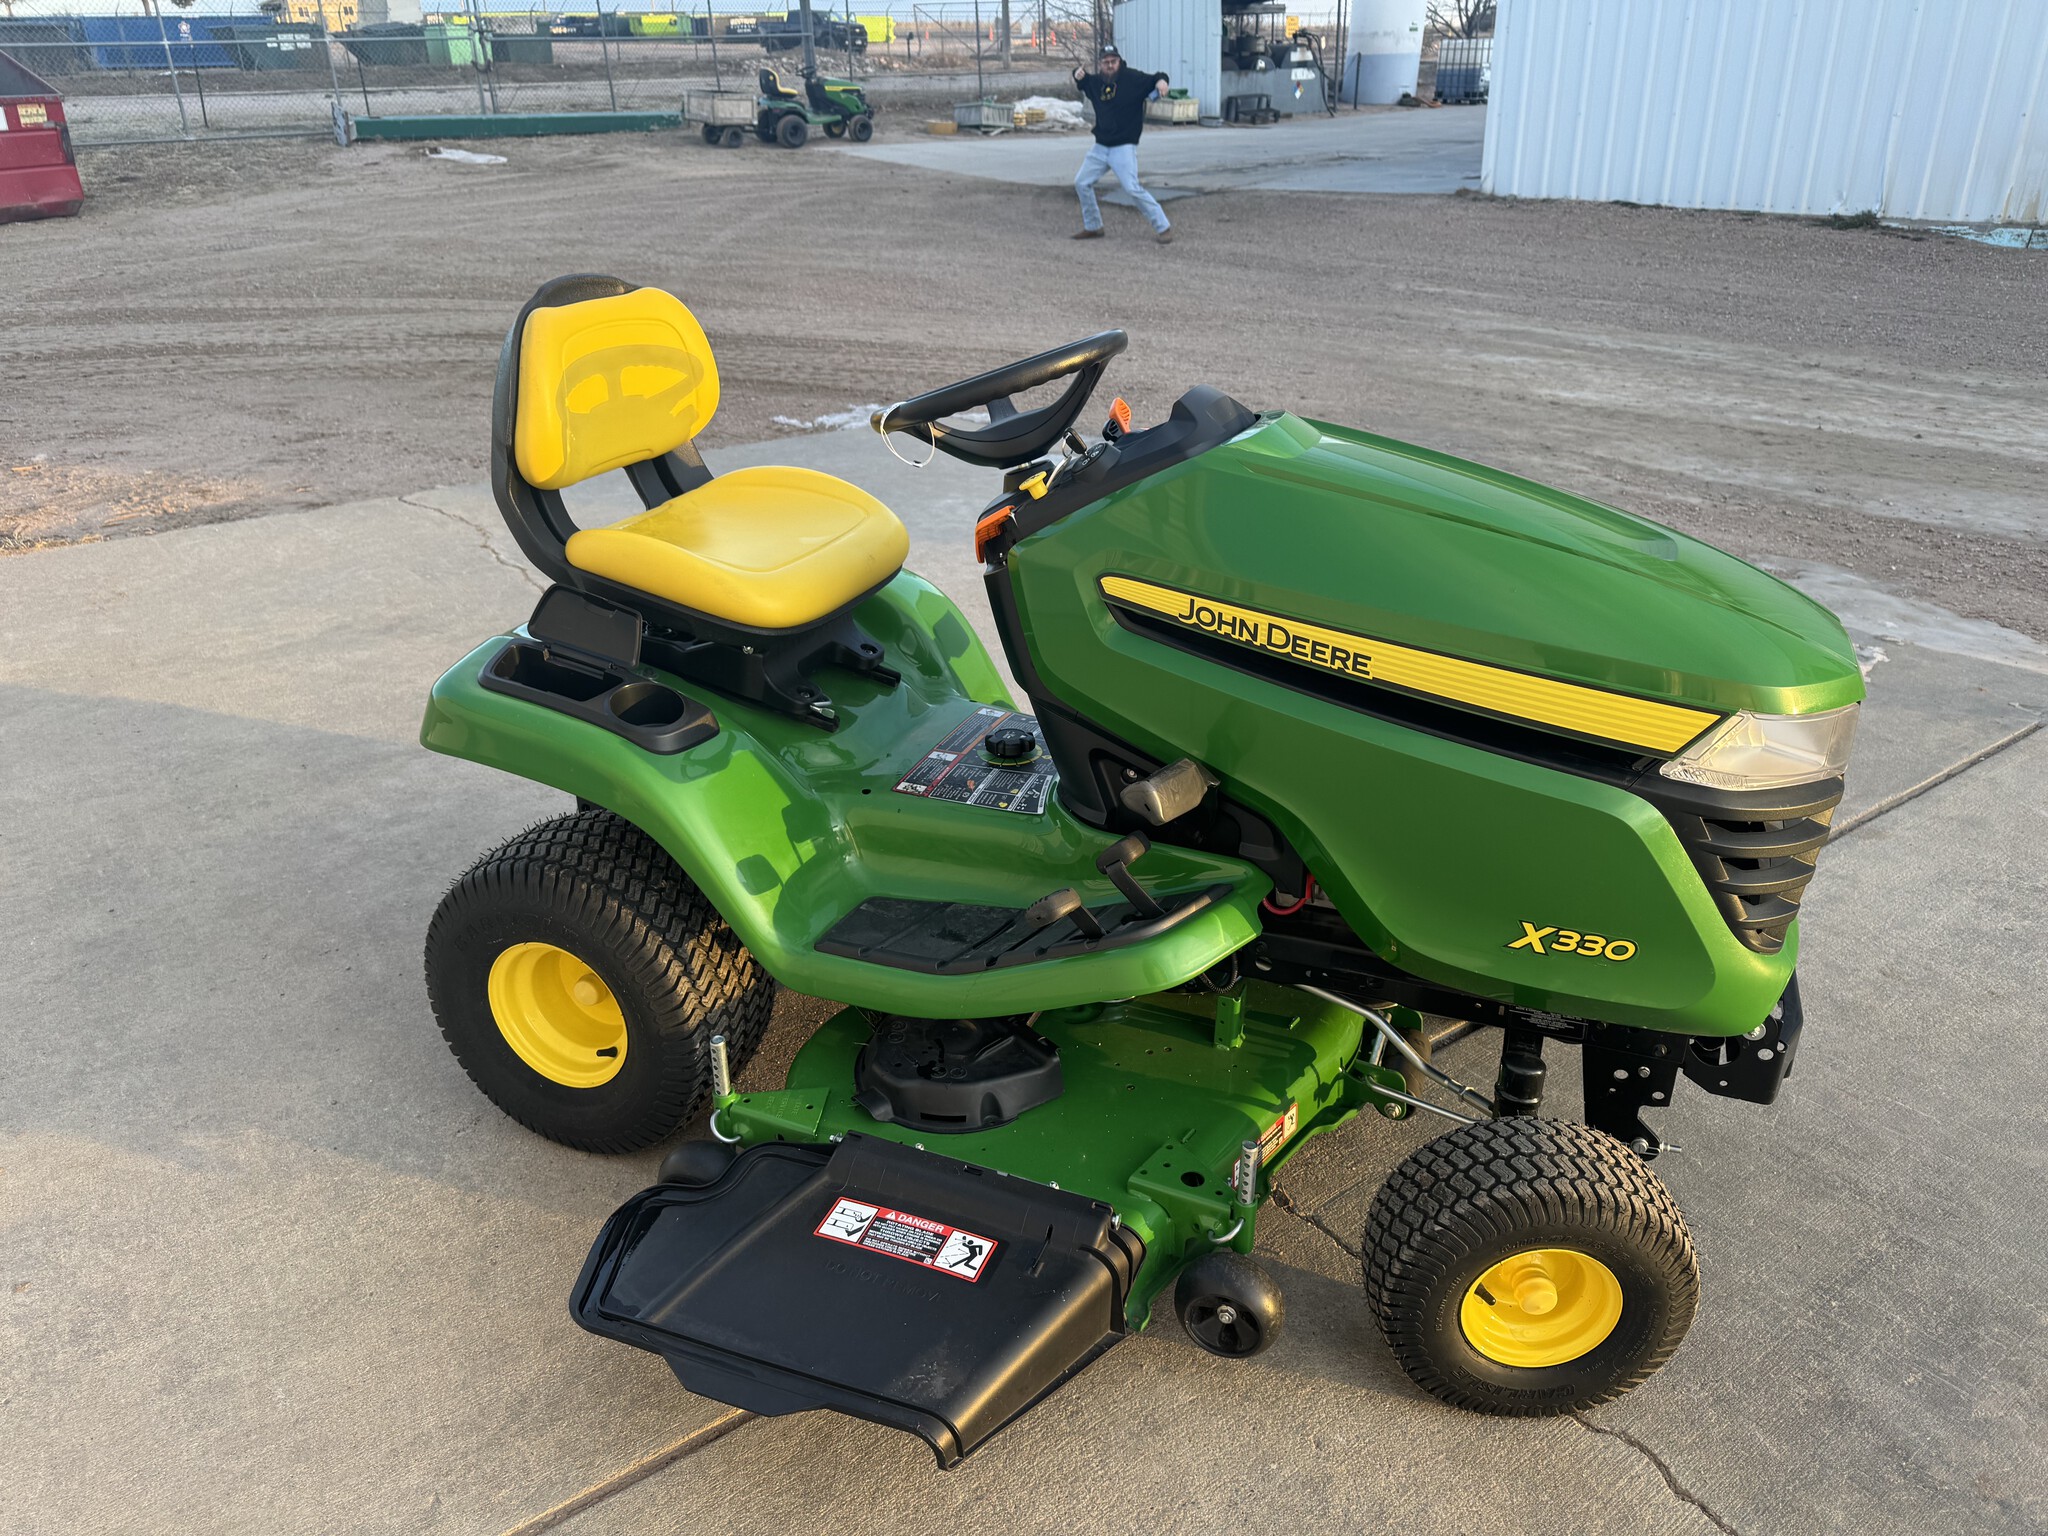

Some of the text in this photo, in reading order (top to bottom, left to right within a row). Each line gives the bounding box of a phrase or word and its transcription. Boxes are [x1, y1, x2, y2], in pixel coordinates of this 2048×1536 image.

[1178, 599, 1373, 676] JOHN DEERE
[1504, 920, 1638, 962] X330
[898, 1214, 944, 1233] DANGER
[1450, 1365, 1577, 1401] CARLISLE
